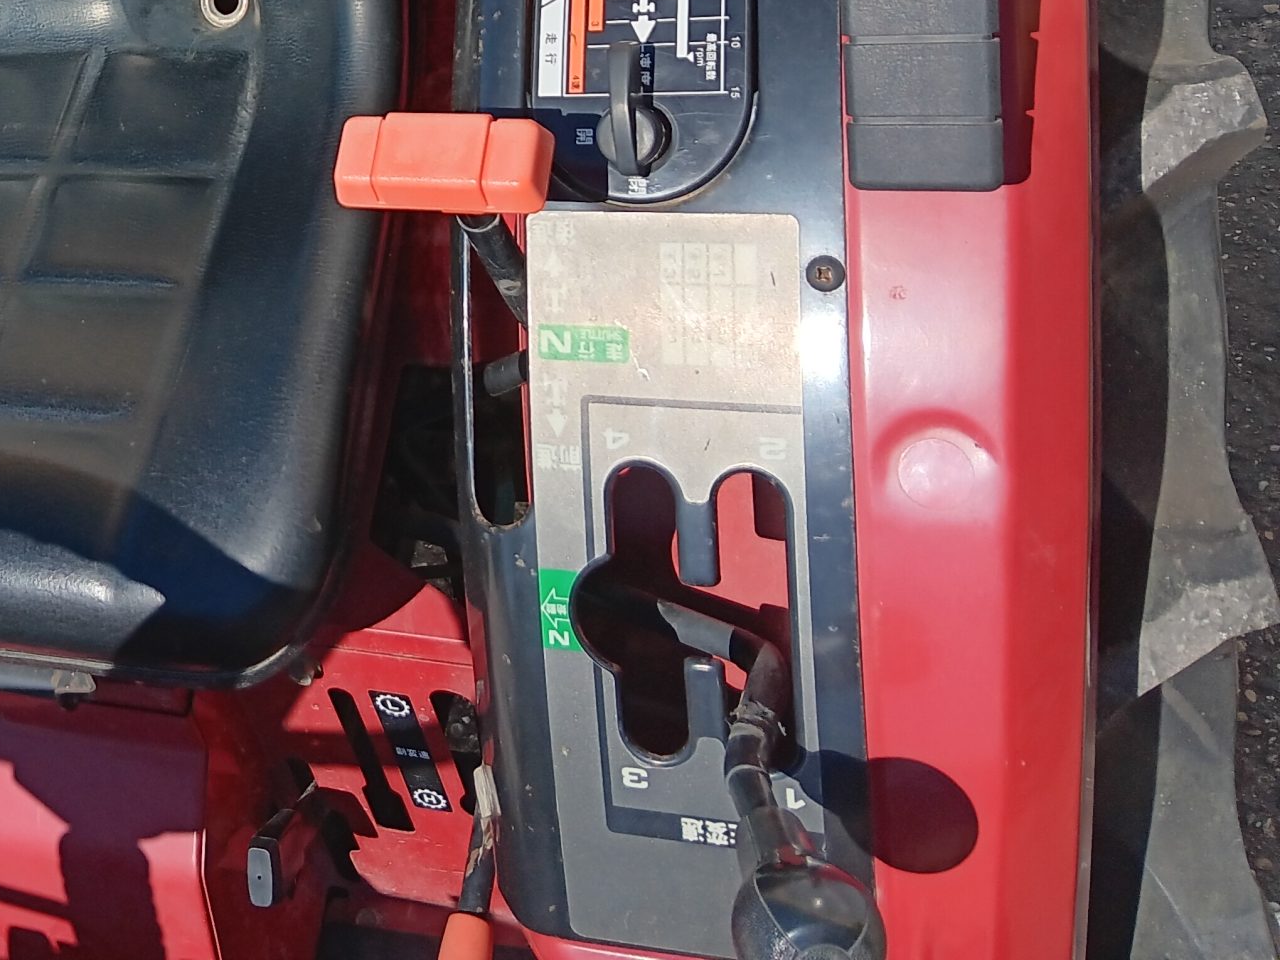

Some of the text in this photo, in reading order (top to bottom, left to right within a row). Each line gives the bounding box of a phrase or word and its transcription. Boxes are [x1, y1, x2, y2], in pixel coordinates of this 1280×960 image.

[546, 32, 558, 65] 走行
[730, 35, 741, 49] 10
[695, 47, 705, 67] rpm
[705, 32, 717, 81] 最高回転数
[571, 74, 581, 91] 4速
[730, 85, 741, 99] 15
[576, 127, 593, 145] 開
[628, 176, 648, 195] 閉
[542, 329, 572, 353] N
[579, 328, 623, 341] SHUTTLE
[578, 341, 624, 361] 走行
[602, 427, 630, 449] 4
[758, 436, 788, 459] 2
[536, 443, 581, 471] 前進
[548, 629, 571, 646] N
[386, 700, 399, 711] L
[621, 767, 650, 790] 3
[422, 794, 434, 804] H
[785, 787, 806, 810] 1
